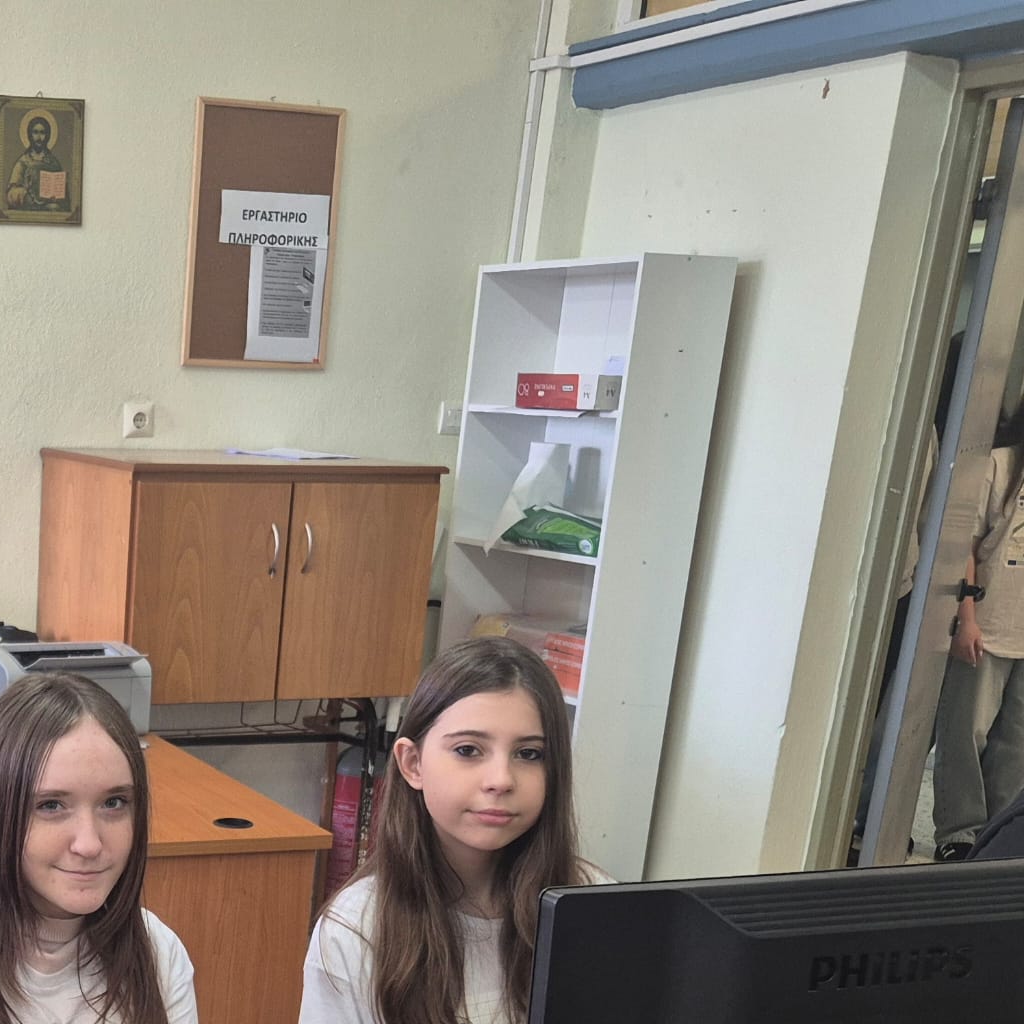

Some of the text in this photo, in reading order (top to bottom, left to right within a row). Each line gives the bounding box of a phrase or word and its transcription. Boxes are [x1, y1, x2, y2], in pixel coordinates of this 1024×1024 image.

[242, 208, 308, 225] ΕΡΓΑΣΤΗΡΙΟ
[228, 232, 318, 247] ΠΛΗΡΟΦΟΡΙΚΗΣ
[807, 946, 975, 993] PHILIPS
